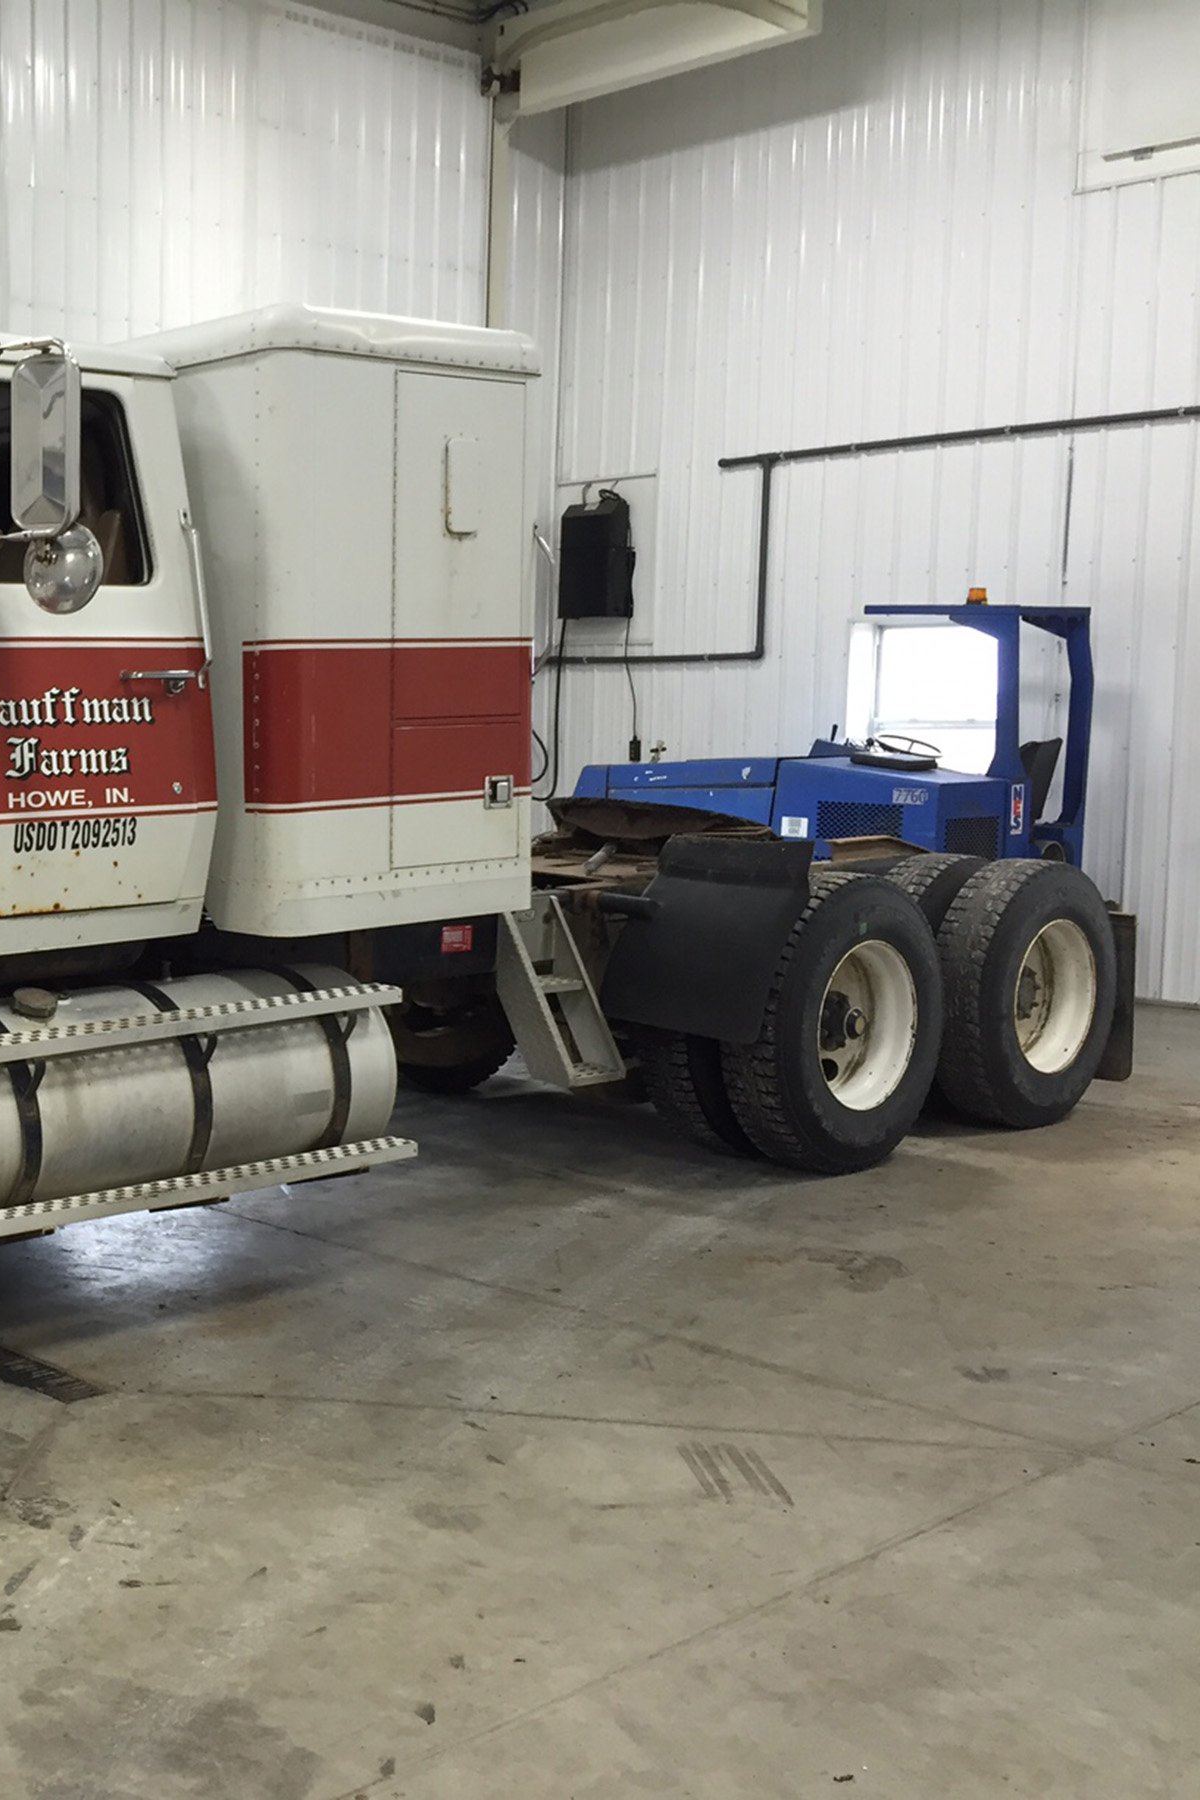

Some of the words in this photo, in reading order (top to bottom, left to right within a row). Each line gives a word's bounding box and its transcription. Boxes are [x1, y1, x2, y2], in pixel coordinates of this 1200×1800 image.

[4, 736, 131, 779] Farms
[7, 789, 94, 809] HOWE,
[105, 787, 136, 805] IN.
[13, 817, 138, 853] USDOT2092513
